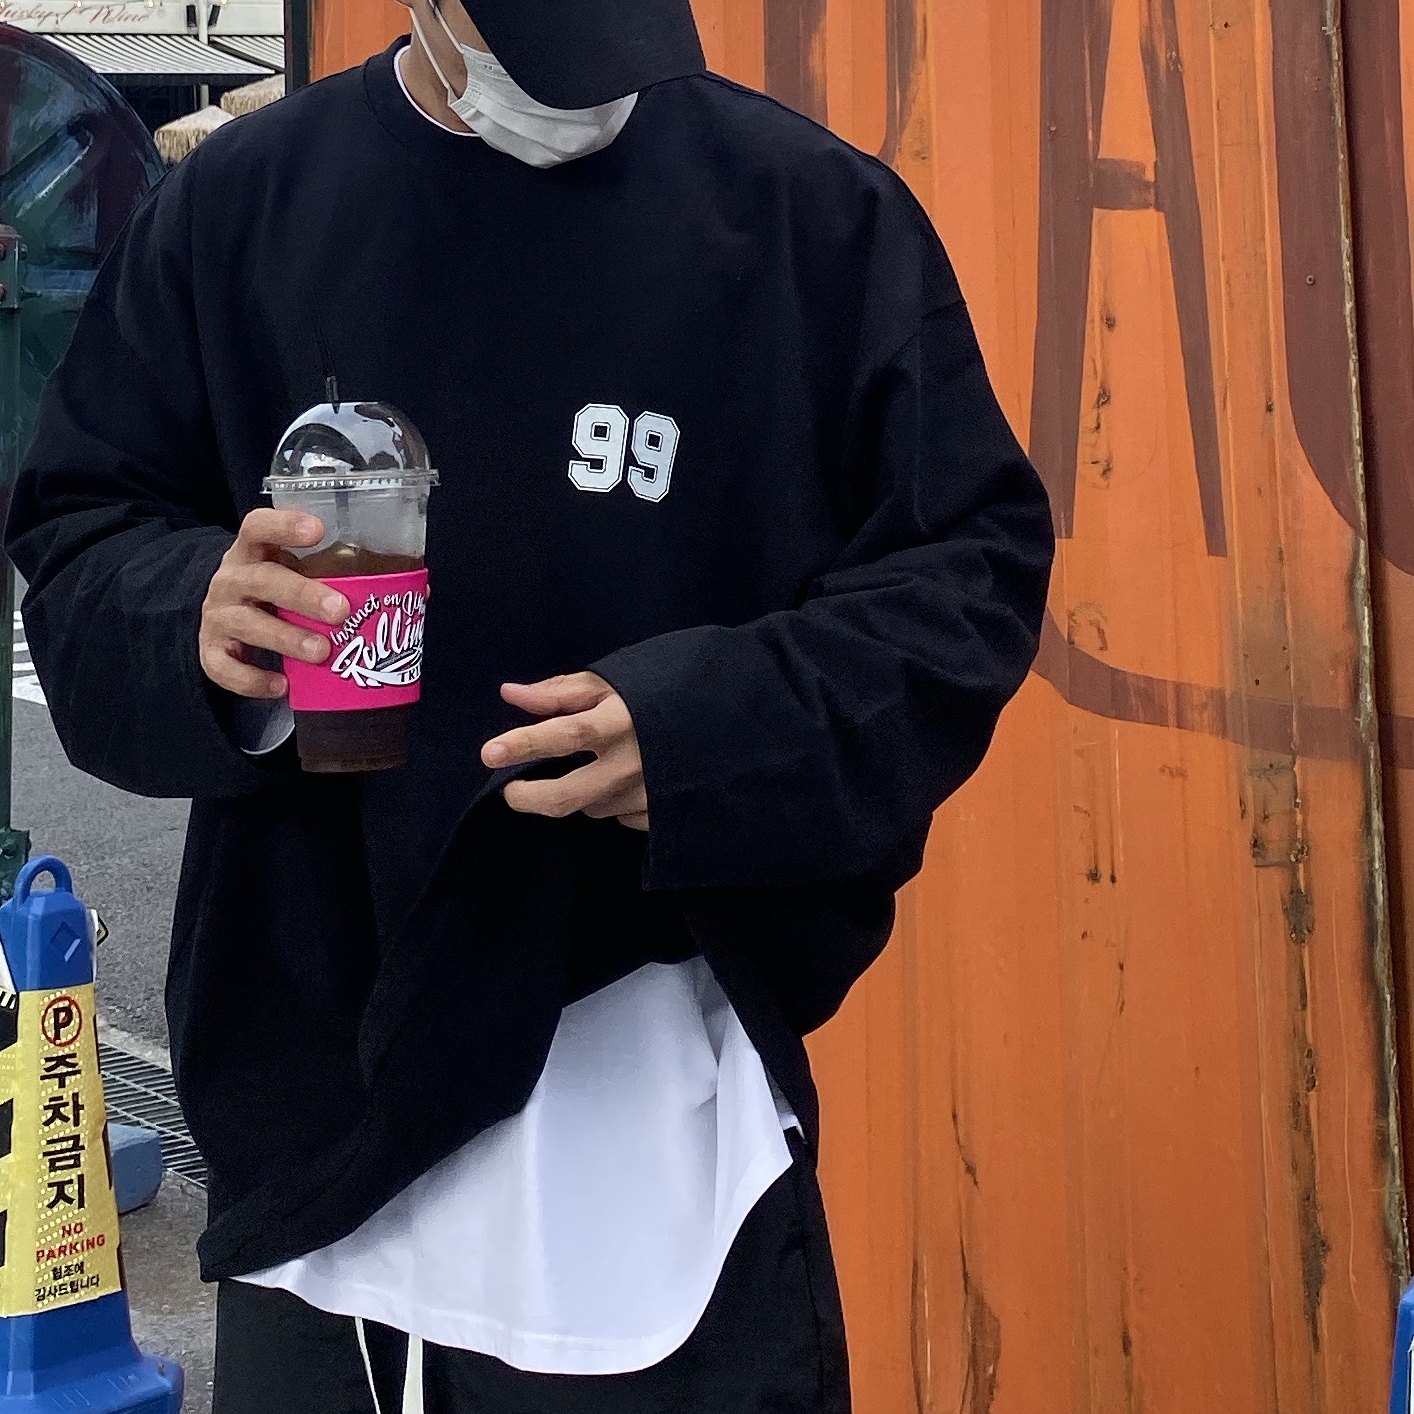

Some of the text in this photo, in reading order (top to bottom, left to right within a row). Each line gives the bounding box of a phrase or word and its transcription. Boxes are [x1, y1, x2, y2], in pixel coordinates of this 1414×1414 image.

[568, 403, 681, 503] 99
[329, 592, 381, 647] Instinct
[383, 592, 402, 607] on
[39, 1052, 86, 1211] 주차금지
[35, 1233, 107, 1263] PARKING
[61, 1221, 85, 1239] NO
